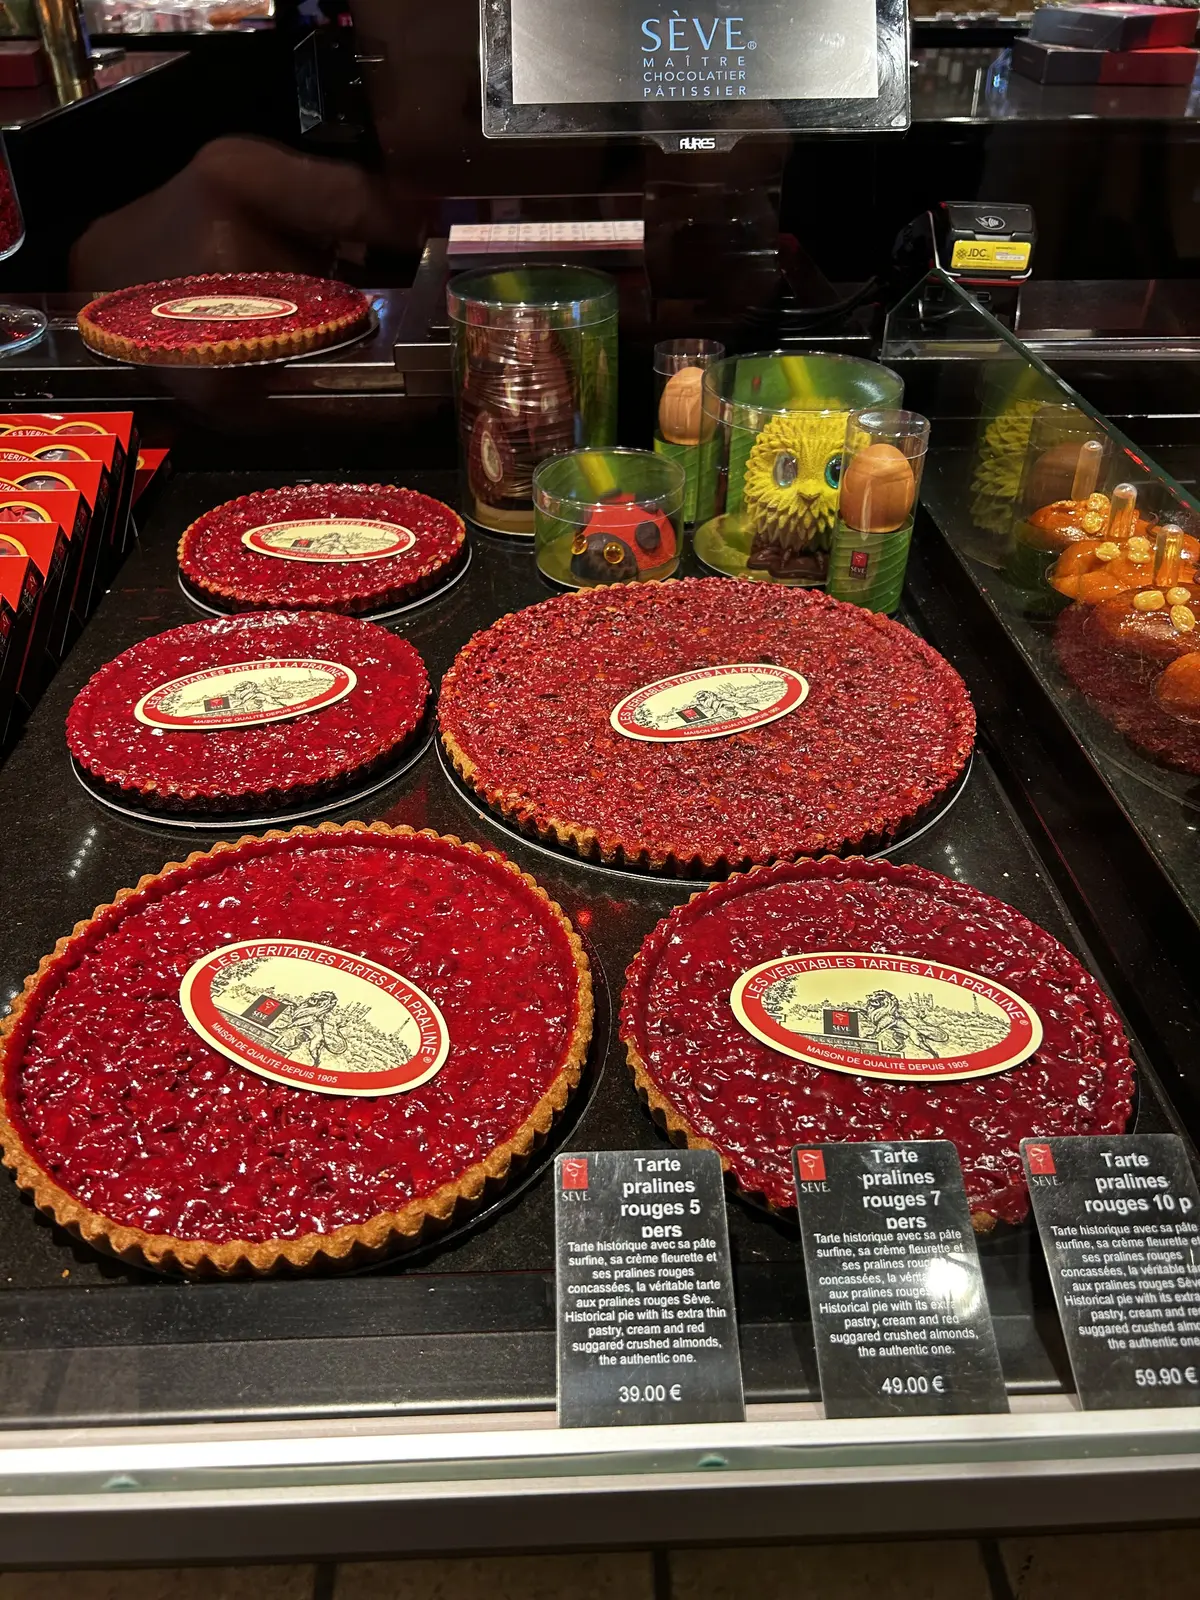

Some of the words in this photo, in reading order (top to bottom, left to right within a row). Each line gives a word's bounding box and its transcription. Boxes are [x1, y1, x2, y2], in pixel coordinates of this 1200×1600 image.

[643, 54, 746, 68] MAÎTRE
[643, 71, 746, 82] CHOCOLATIER
[644, 84, 746, 97] PÂTISSIER
[680, 138, 715, 150] AURES
[968, 249, 987, 257] JDC
[208, 952, 240, 972] LES
[246, 945, 337, 965] VERITABLES
[337, 957, 388, 986] TARTES
[393, 989, 413, 1007] LA
[746, 979, 768, 999] LES
[766, 959, 856, 980] VERITABLES
[859, 959, 920, 974] TARTES
[939, 971, 958, 985] LA
[212, 1022, 236, 1046] MAISON
[235, 1040, 248, 1053] DE
[283, 1063, 314, 1079] DEPUIS
[317, 1073, 337, 1084] 1905
[806, 1045, 845, 1061] MAISON
[846, 1056, 860, 1064] DE
[908, 1061, 945, 1071] DEPUIS
[948, 1061, 969, 1069] 1905
[871, 1150, 918, 1163] Tarte
[1100, 1152, 1150, 1167] Tarte
[634, 1158, 681, 1171] Tarte
[863, 1170, 935, 1188] pralines
[1095, 1175, 1168, 1192] pralines
[623, 1179, 695, 1197] pralines
[863, 1193, 926, 1210] rouges
[930, 1191, 940, 1206] 7
[1084, 1197, 1148, 1215] rouges
[1153, 1194, 1174, 1210] 10
[621, 1202, 684, 1219] rouges
[690, 1199, 700, 1214] 5
[1051, 1226, 1077, 1235] Tarte
[1080, 1224, 1129, 1236] historique
[1133, 1225, 1157, 1233] avec
[1175, 1222, 1197, 1233] pâte
[814, 1233, 840, 1243] Tarte
[843, 1231, 893, 1245] historique
[897, 1232, 921, 1240] avec
[924, 1231, 936, 1240] sa
[939, 1229, 961, 1241] pâte
[1055, 1239, 1094, 1250] surfine,
[1097, 1240, 1109, 1248] sa
[1112, 1238, 1144, 1247] crème
[1147, 1236, 1188, 1246] fleurette
[568, 1242, 594, 1252] Tarte
[597, 1241, 647, 1253] historique
[651, 1241, 675, 1249] avec
[693, 1238, 716, 1250] pâte
[817, 1247, 855, 1258] surfine,
[859, 1247, 871, 1256] sa
[874, 1245, 905, 1255] crème
[909, 1243, 950, 1253] fleurette
[954, 1243, 964, 1252] et
[569, 1255, 607, 1266] surfine,
[610, 1256, 623, 1264] sa
[626, 1253, 658, 1264] crème
[661, 1253, 703, 1262] fleurette
[706, 1253, 717, 1262] et
[842, 1261, 860, 1270] ses
[864, 1259, 904, 1271] pralines
[592, 1271, 611, 1279] ses
[614, 1268, 655, 1280] pralines
[658, 1268, 694, 1278] rouges
[819, 1274, 884, 1285] concassées,
[887, 1273, 897, 1283] la
[568, 1283, 633, 1293] concassées,
[636, 1282, 645, 1291] la
[649, 1280, 693, 1291] véritable
[696, 1280, 720, 1289] tarte
[829, 1291, 849, 1299] aux
[851, 1288, 892, 1300] pralines
[576, 1300, 596, 1308] aux
[599, 1297, 640, 1309] pralines
[644, 1296, 679, 1307] rouges
[683, 1294, 714, 1304] Sève.
[820, 1302, 869, 1313] Historical
[873, 1302, 888, 1314] pie
[891, 1301, 912, 1311] with
[915, 1300, 928, 1310] its
[565, 1311, 615, 1322] Historical
[618, 1311, 634, 1323] pie
[637, 1310, 659, 1320] with
[662, 1309, 674, 1318] its
[677, 1309, 703, 1318] extra
[706, 1307, 726, 1318] thin
[844, 1317, 880, 1330] pastry,
[882, 1316, 916, 1326] cream
[919, 1314, 938, 1324] and
[588, 1326, 624, 1338] pastry,
[626, 1325, 660, 1335] cream
[664, 1323, 684, 1333] and
[687, 1322, 704, 1332] red
[830, 1330, 880, 1344] suggared
[884, 1330, 926, 1341] crushed
[930, 1328, 978, 1339] almonds,
[572, 1339, 624, 1352] suggared
[626, 1338, 669, 1349] crushed
[673, 1337, 722, 1348] almonds,
[858, 1346, 875, 1357] the
[879, 1344, 928, 1355] authentic
[931, 1345, 955, 1354] one.
[599, 1354, 616, 1365] the
[620, 1353, 670, 1364] authentic
[673, 1352, 696, 1362] one.
[1135, 1368, 1182, 1386] 59.90
[1185, 1367, 1198, 1383] €
[882, 1377, 928, 1394] 49.00
[932, 1376, 944, 1392] €
[619, 1385, 665, 1402] 39.00
[669, 1384, 681, 1400] €
